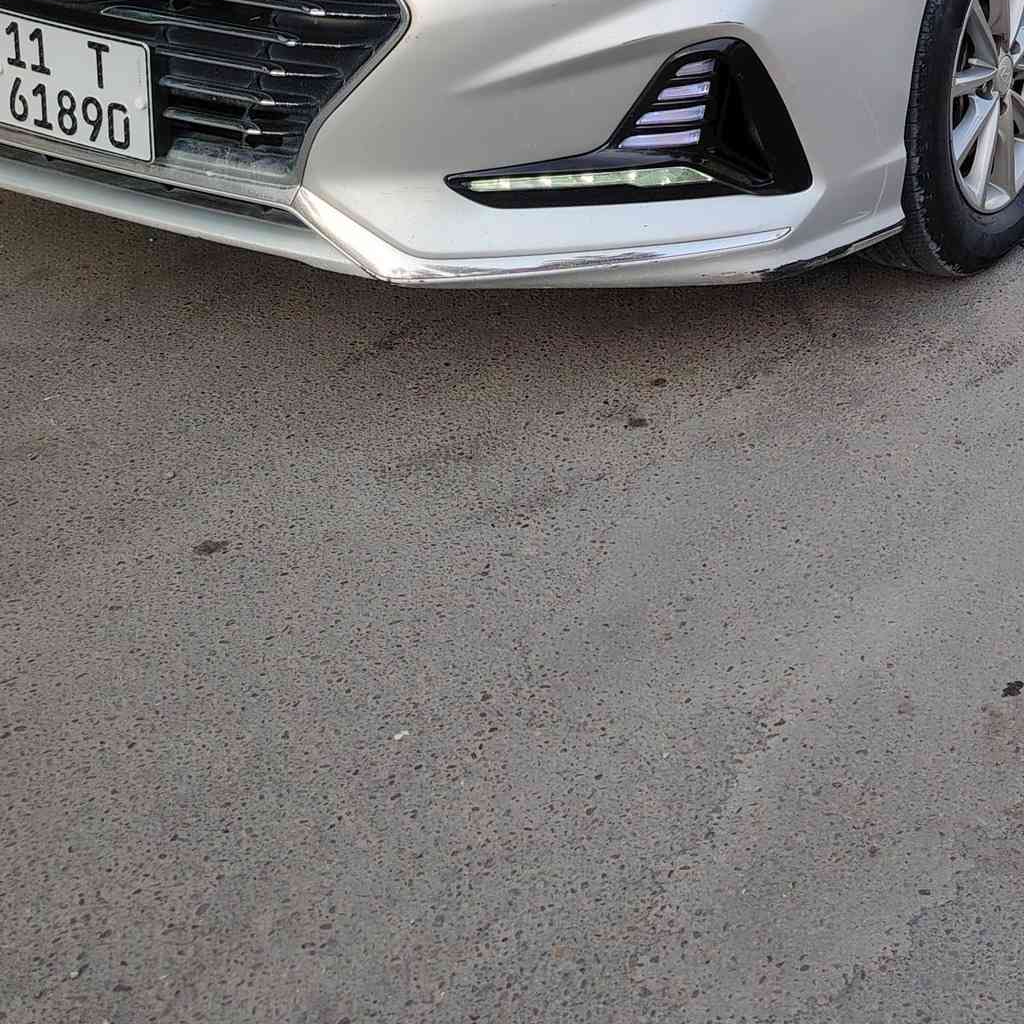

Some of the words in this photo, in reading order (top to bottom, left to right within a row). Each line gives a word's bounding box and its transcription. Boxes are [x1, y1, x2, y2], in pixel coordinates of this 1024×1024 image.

[5, 21, 51, 76] 11
[87, 40, 110, 89] T
[9, 77, 131, 150] 61890
